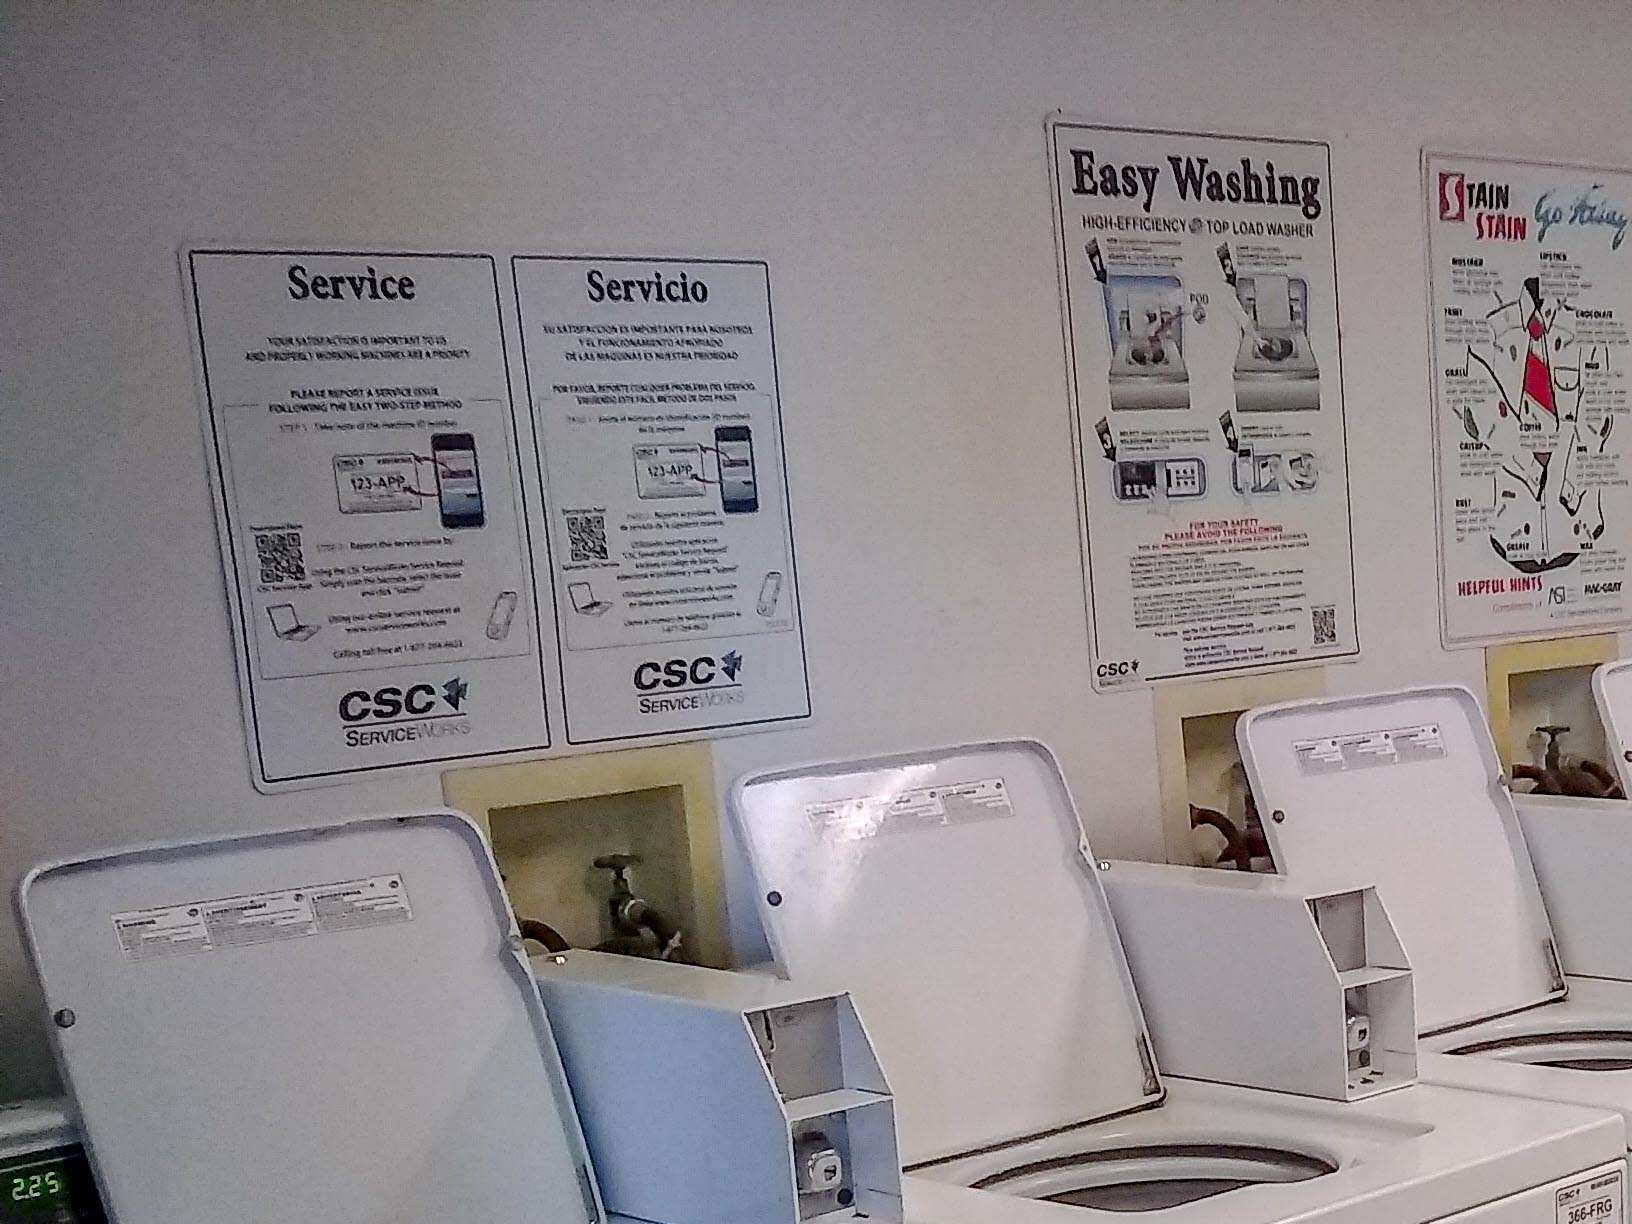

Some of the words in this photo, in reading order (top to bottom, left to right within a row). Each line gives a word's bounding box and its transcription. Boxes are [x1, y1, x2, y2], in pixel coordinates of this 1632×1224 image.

[1069, 149, 1160, 213] Easy
[1167, 156, 1322, 220] Washing
[1439, 172, 1509, 221] STAIN
[1476, 213, 1526, 240] STAIN
[1081, 214, 1187, 233] HIGH-EFFICIENCY
[1206, 219, 1230, 235] TOP
[1232, 221, 1264, 236] LOAD
[1266, 223, 1315, 238] WASHER
[288, 264, 416, 301] Service
[587, 269, 709, 304] Servicio
[1189, 293, 1209, 306] POD
[351, 475, 405, 493] 123-APP
[1458, 580, 1504, 597] HELPFUL
[1510, 575, 1543, 592] HINTS
[634, 656, 715, 691] CSC
[1097, 662, 1129, 678] CSC
[339, 684, 435, 722] CSC
